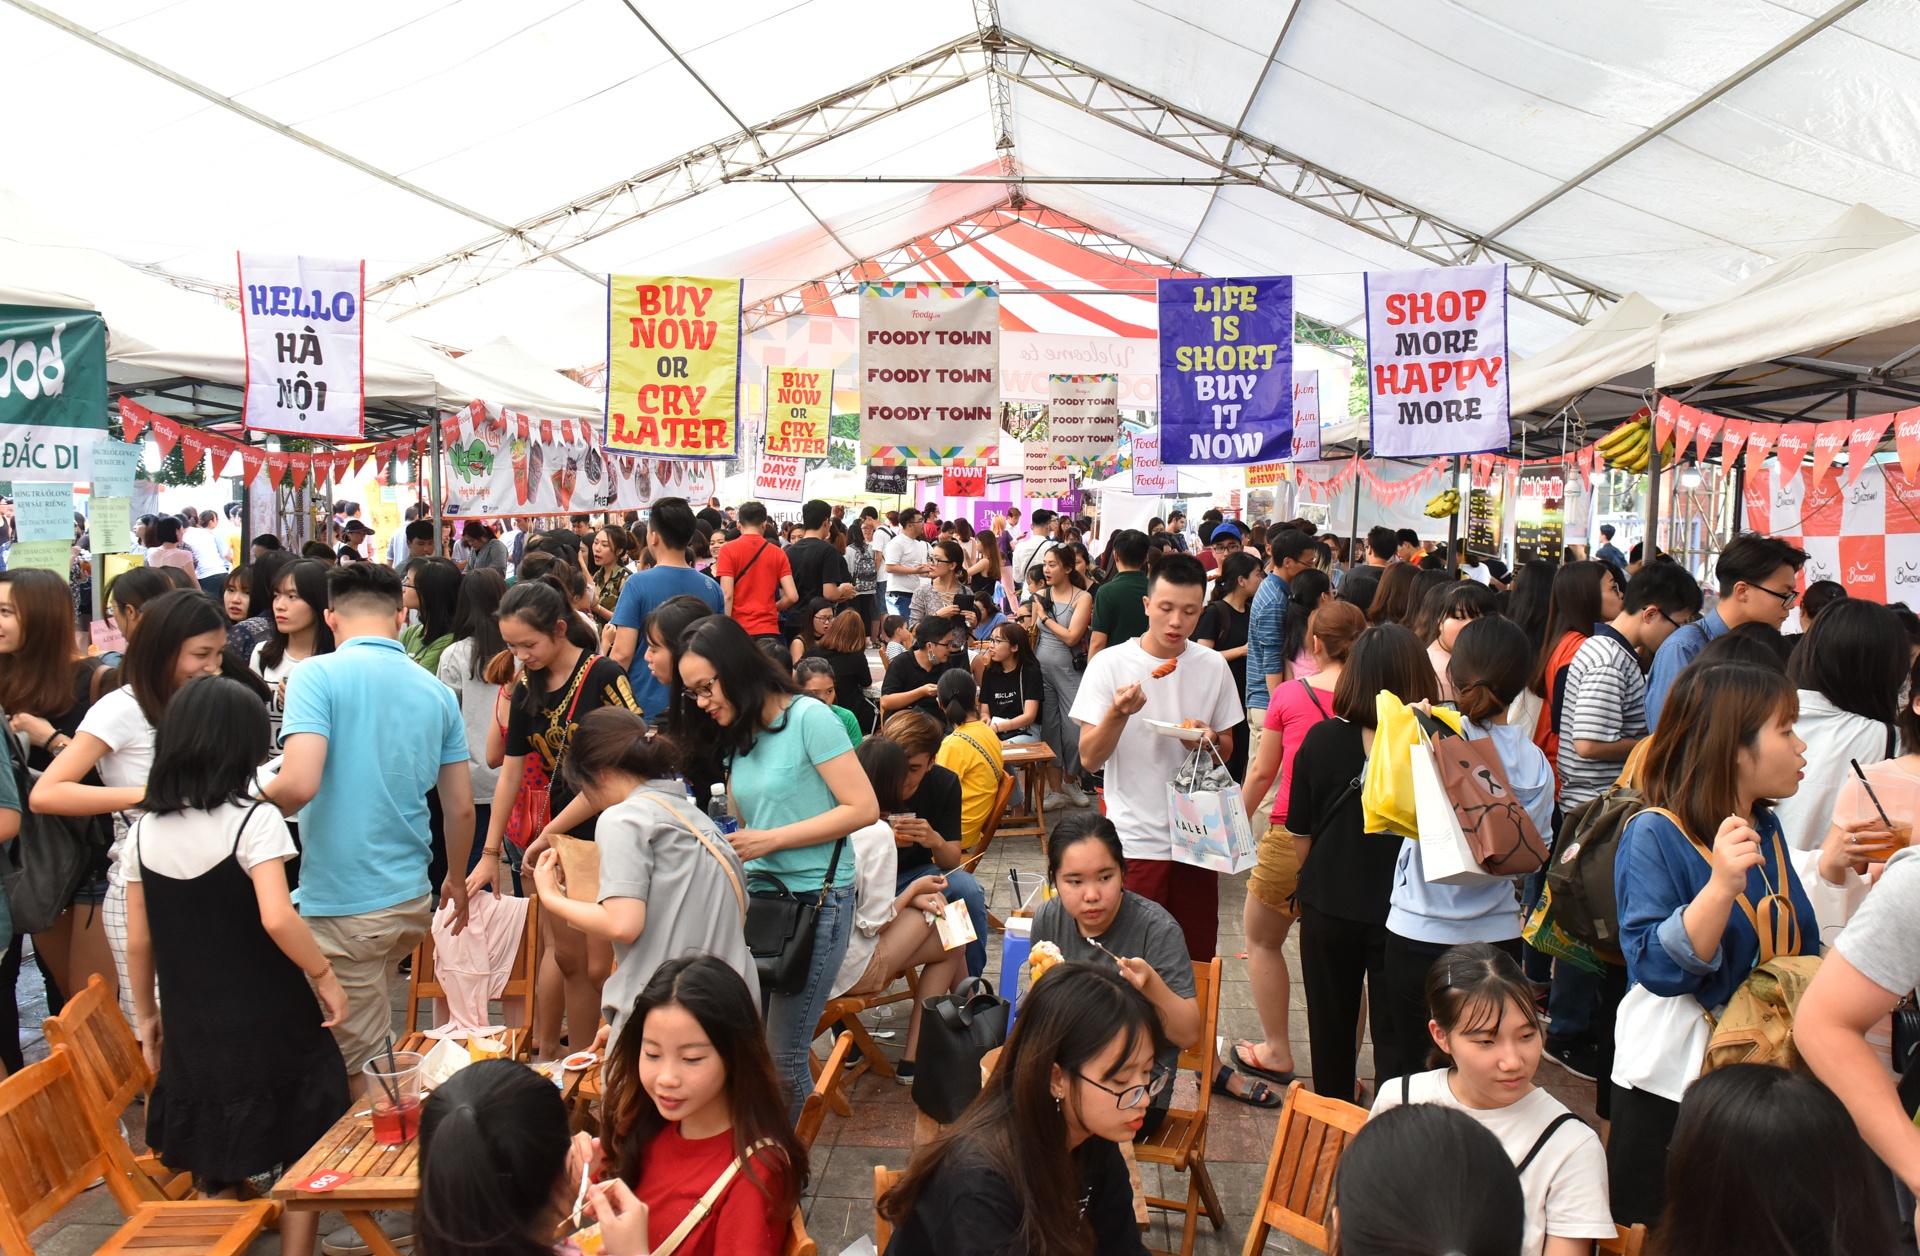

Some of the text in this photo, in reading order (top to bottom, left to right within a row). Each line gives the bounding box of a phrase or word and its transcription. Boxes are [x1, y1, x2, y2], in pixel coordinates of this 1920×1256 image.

[248, 284, 355, 323] HELLO
[636, 284, 713, 318] BUY
[1192, 285, 1258, 313] LIFE
[1385, 289, 1488, 326] SHOP
[629, 316, 718, 351] NOW
[868, 331, 991, 345] FOODY TOWN
[1211, 315, 1240, 342] IS
[275, 325, 324, 366] HÀ
[1394, 329, 1479, 357] MORE
[656, 355, 689, 379] OR
[1175, 343, 1277, 372] SHORT
[781, 372, 820, 389] BUY
[868, 368, 991, 383] FOODY TOWN
[1195, 374, 1258, 401] BUY
[1374, 356, 1502, 395] HAPPY
[276, 371, 328, 421] NỘI
[637, 383, 707, 417] CRY
[777, 388, 822, 406] NOW
[1052, 398, 1115, 406] FOODY TOWN
[790, 407, 807, 419] OR
[868, 406, 991, 420] FOODY TOWN
[1052, 416, 1115, 424] FOODY TOWN
[1212, 404, 1242, 430] IT
[1397, 397, 1482, 426] MORE
[611, 413, 729, 450] LATER
[780, 420, 817, 438] CRY
[1052, 435, 1115, 443] FOODY TOWN
[2, 431, 79, 469] ĐẮC DI
[767, 435, 826, 454] LATER
[1189, 431, 1264, 460] NOW
[762, 462, 797, 477] DAYS
[945, 466, 983, 478] TOWN
[756, 475, 802, 491] ONLY!!!
[1174, 817, 1208, 836] KALEI
